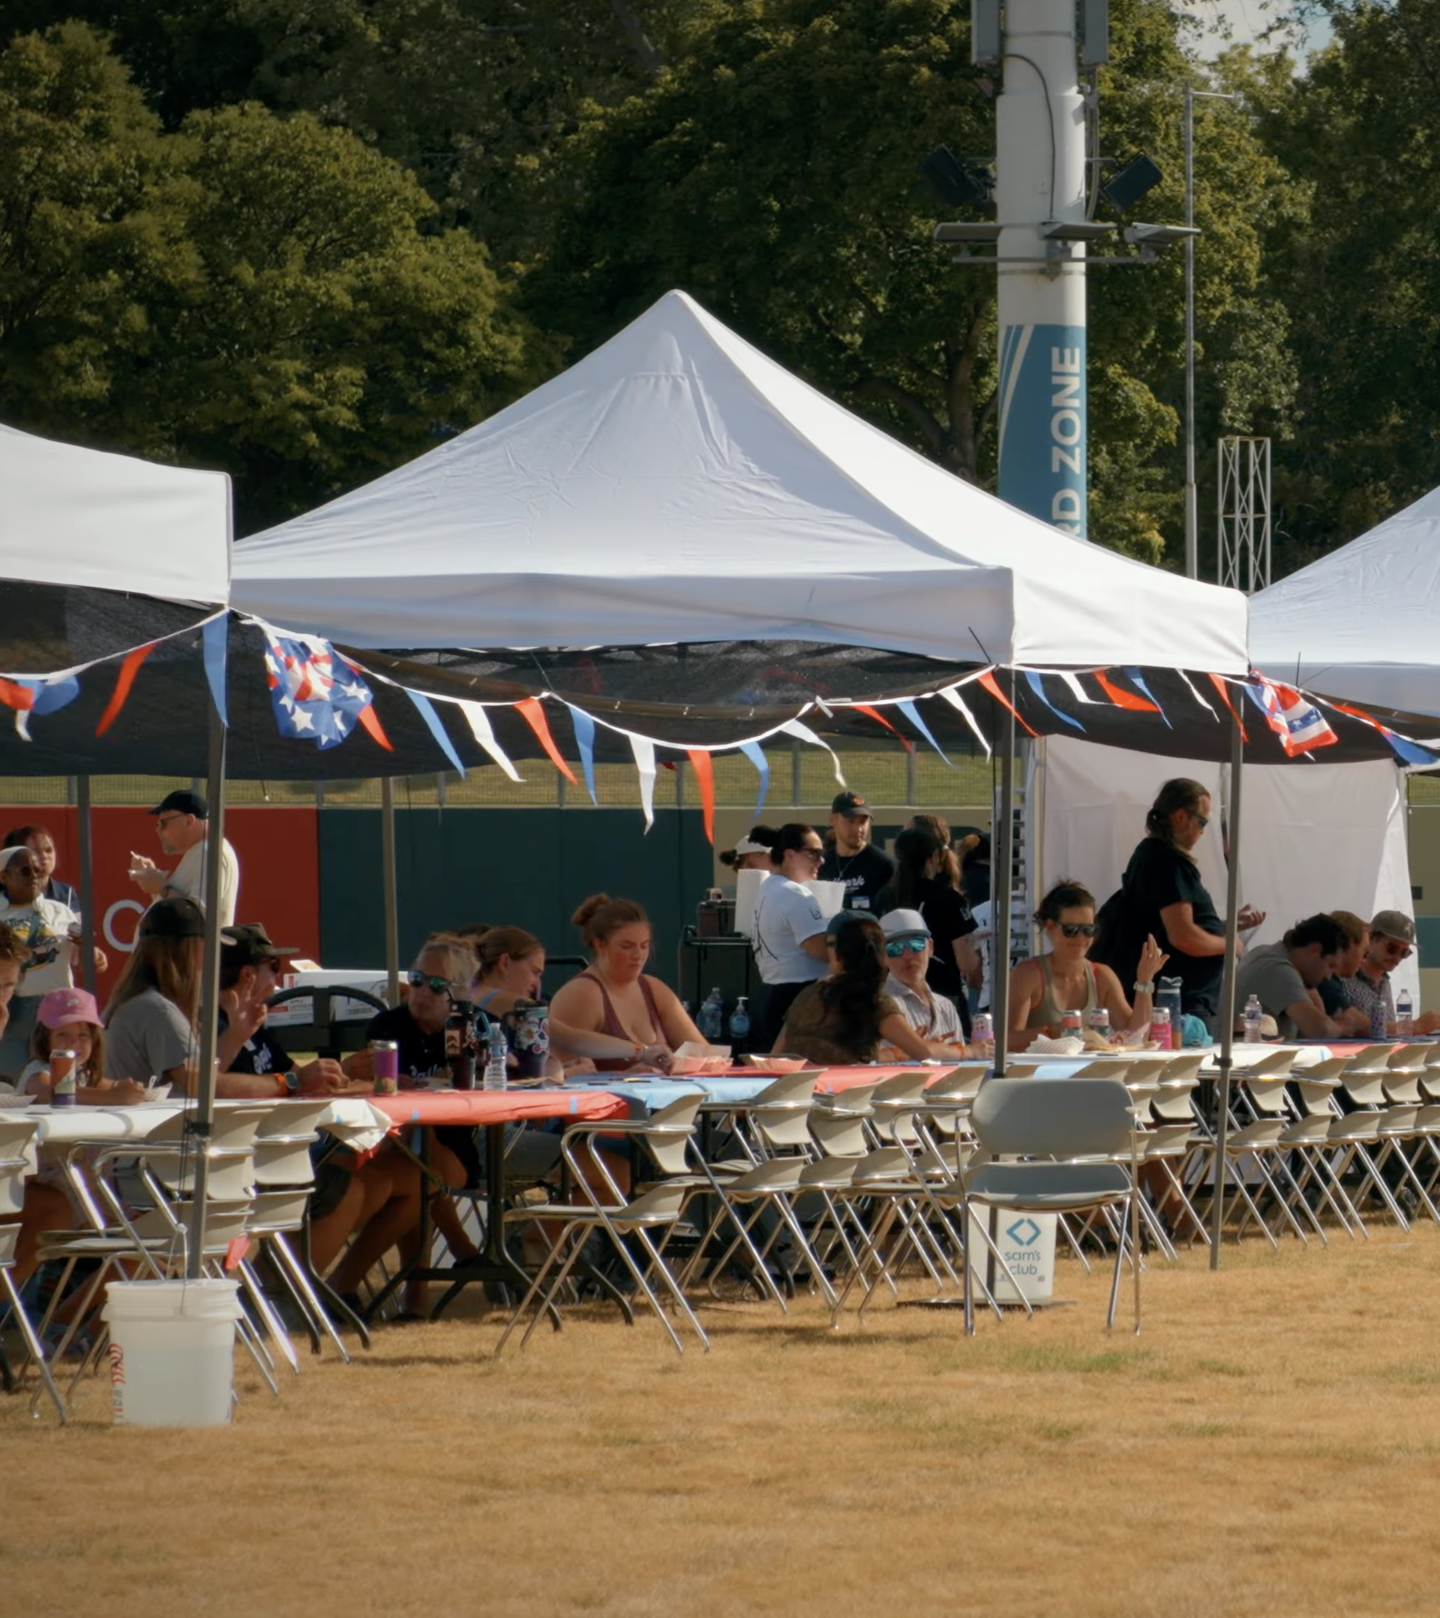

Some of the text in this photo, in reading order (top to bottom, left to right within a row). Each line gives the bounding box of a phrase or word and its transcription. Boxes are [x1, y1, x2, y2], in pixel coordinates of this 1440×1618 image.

[1051, 346, 1081, 474] ZONE
[1005, 1250, 1041, 1261] sam's
[1008, 1263, 1038, 1276] club
